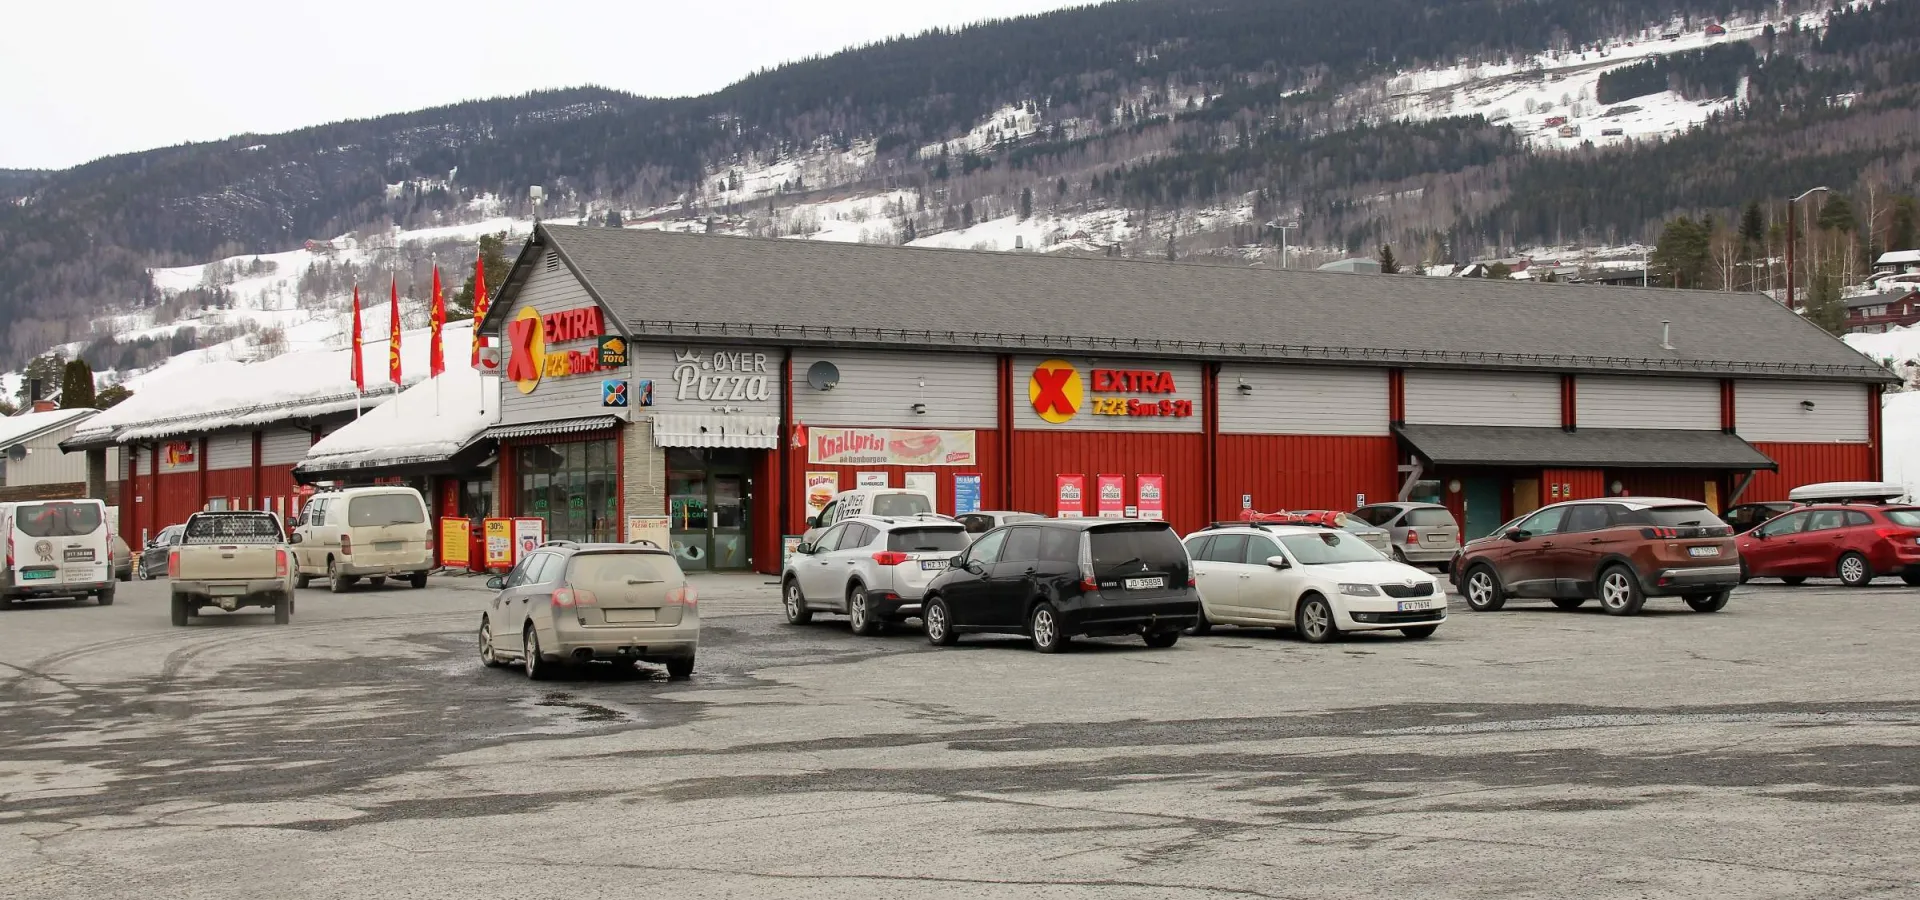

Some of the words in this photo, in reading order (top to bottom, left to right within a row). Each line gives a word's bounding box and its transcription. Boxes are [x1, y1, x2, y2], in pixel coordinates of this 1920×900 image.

[543, 305, 605, 343] EXTRA
[544, 350, 569, 377] -23
[602, 355, 625, 363] TOTO
[713, 351, 767, 372] ØYER
[673, 361, 771, 401] Pizza
[1033, 368, 1077, 414] X
[1091, 369, 1176, 393] EXTRA
[817, 430, 886, 461] Knallpris!
[848, 455, 888, 463] hamburgere
